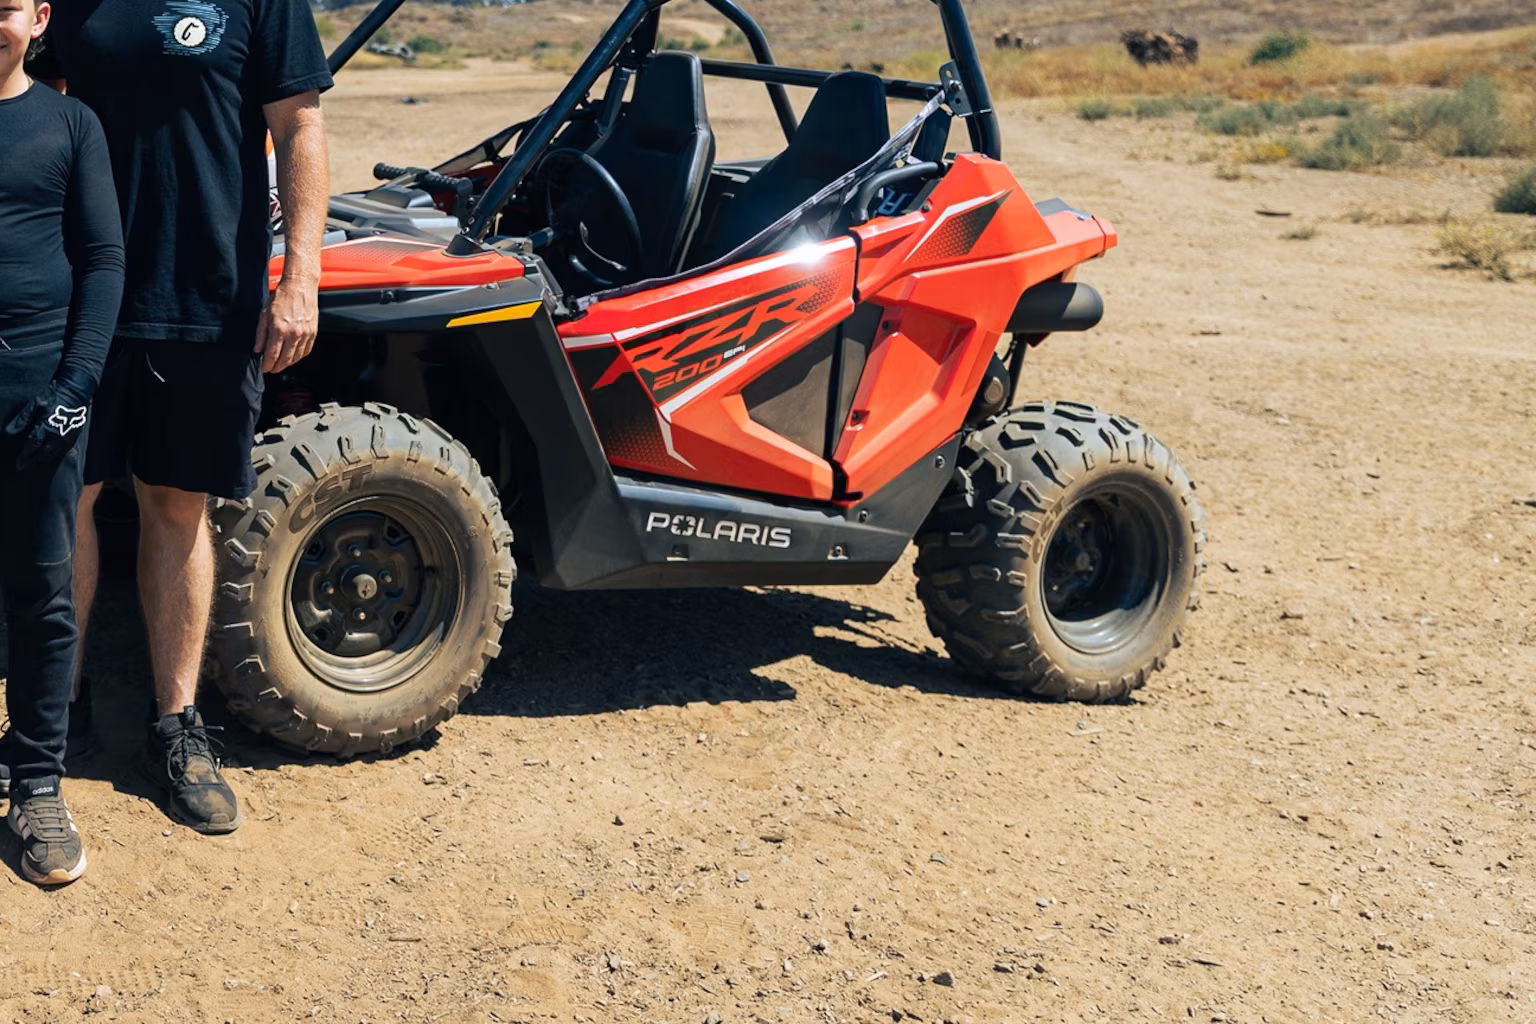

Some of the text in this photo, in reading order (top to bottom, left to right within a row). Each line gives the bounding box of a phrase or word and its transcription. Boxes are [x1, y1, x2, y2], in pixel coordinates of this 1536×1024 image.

[591, 284, 820, 391] RZR
[653, 353, 723, 391] 200
[288, 463, 373, 534] CST
[645, 512, 792, 549] POLARIS
[32, 785, 55, 795] adidas
